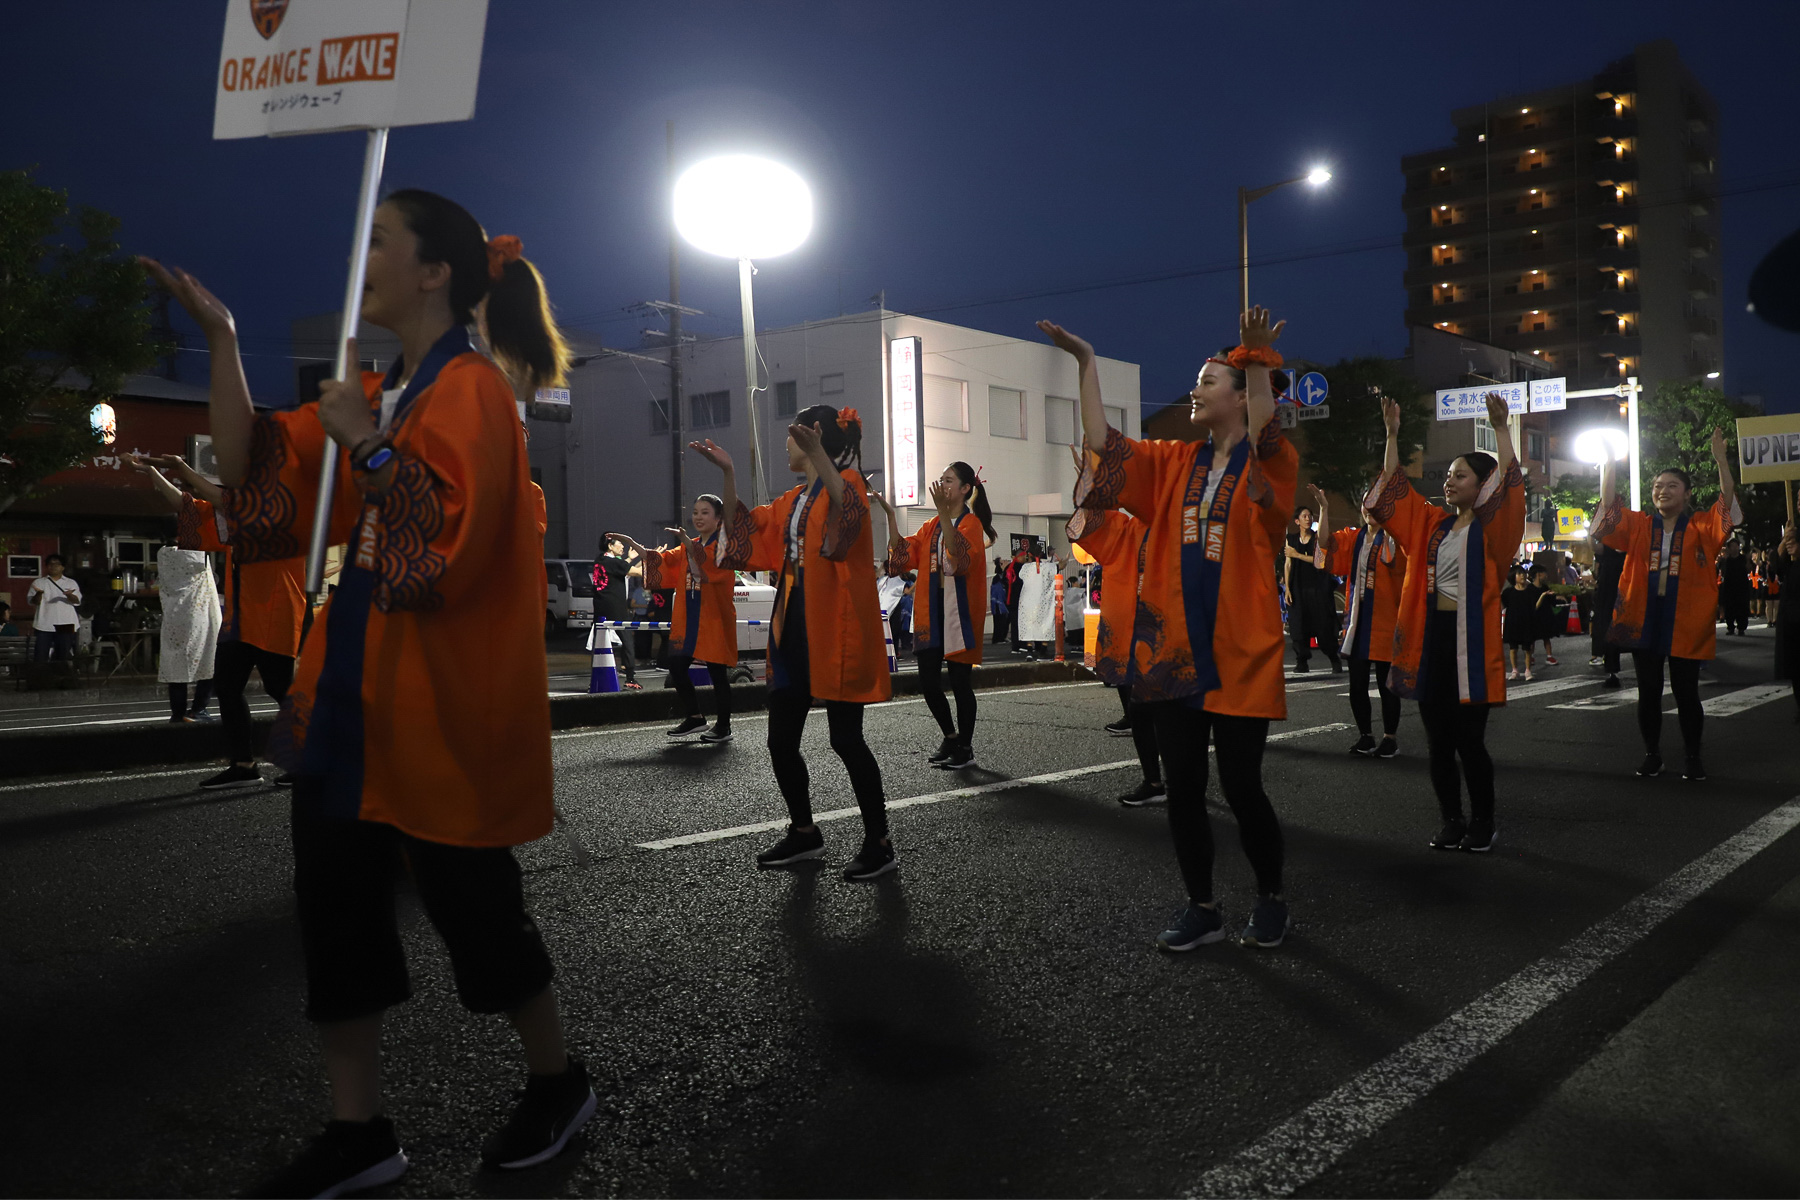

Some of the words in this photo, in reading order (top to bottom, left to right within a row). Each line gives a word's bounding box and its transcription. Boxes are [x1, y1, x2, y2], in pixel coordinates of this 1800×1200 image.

[222, 47, 312, 92] ORANGE
[322, 37, 396, 81] WAVE
[1534, 383, 1562, 395] この先
[1534, 395, 1562, 407] 信号機
[1441, 408, 1457, 416] 100m
[1458, 405, 1476, 415] Shimizu
[1212, 474, 1237, 519] ORANGE
[357, 507, 378, 568] WAVE
[1183, 507, 1197, 542] WAVE
[1206, 524, 1224, 561] WAVE
[1427, 529, 1446, 564] ORANGE
[1426, 566, 1436, 592] WAVE
